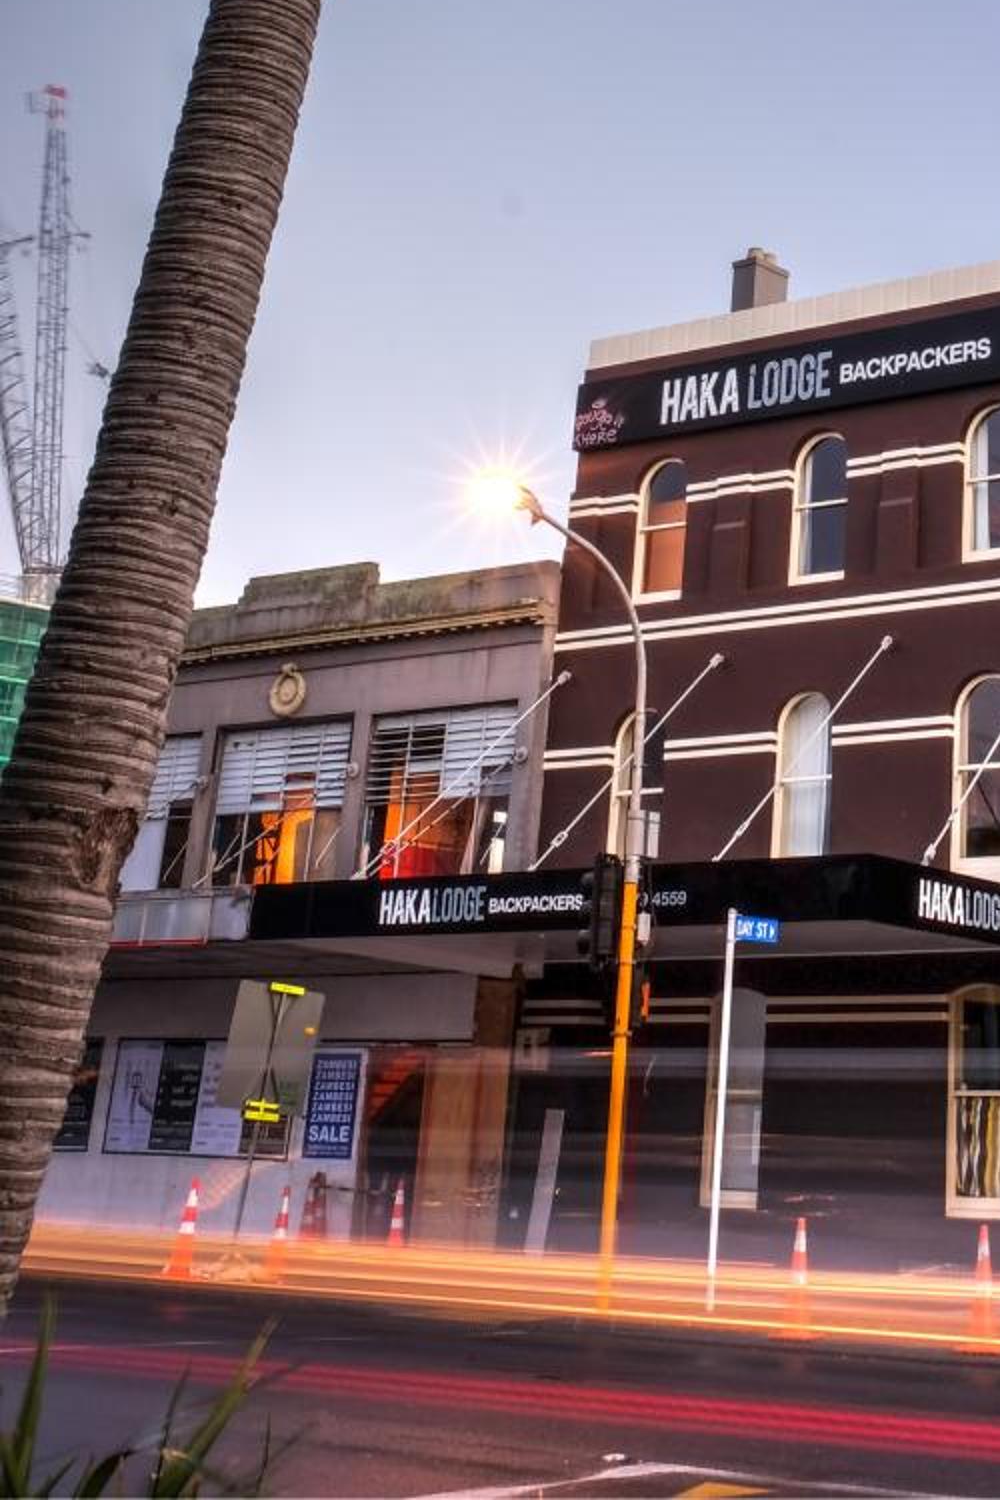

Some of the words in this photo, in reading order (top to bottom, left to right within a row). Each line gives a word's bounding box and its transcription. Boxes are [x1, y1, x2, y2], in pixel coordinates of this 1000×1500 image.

[659, 368, 740, 425] HAKA
[747, 351, 833, 410] LODGE
[839, 337, 992, 385] BACKPACKERS
[488, 893, 584, 915] BACKPACKERS
[757, 921, 769, 939] ST
[309, 1125, 351, 1142] SALE
